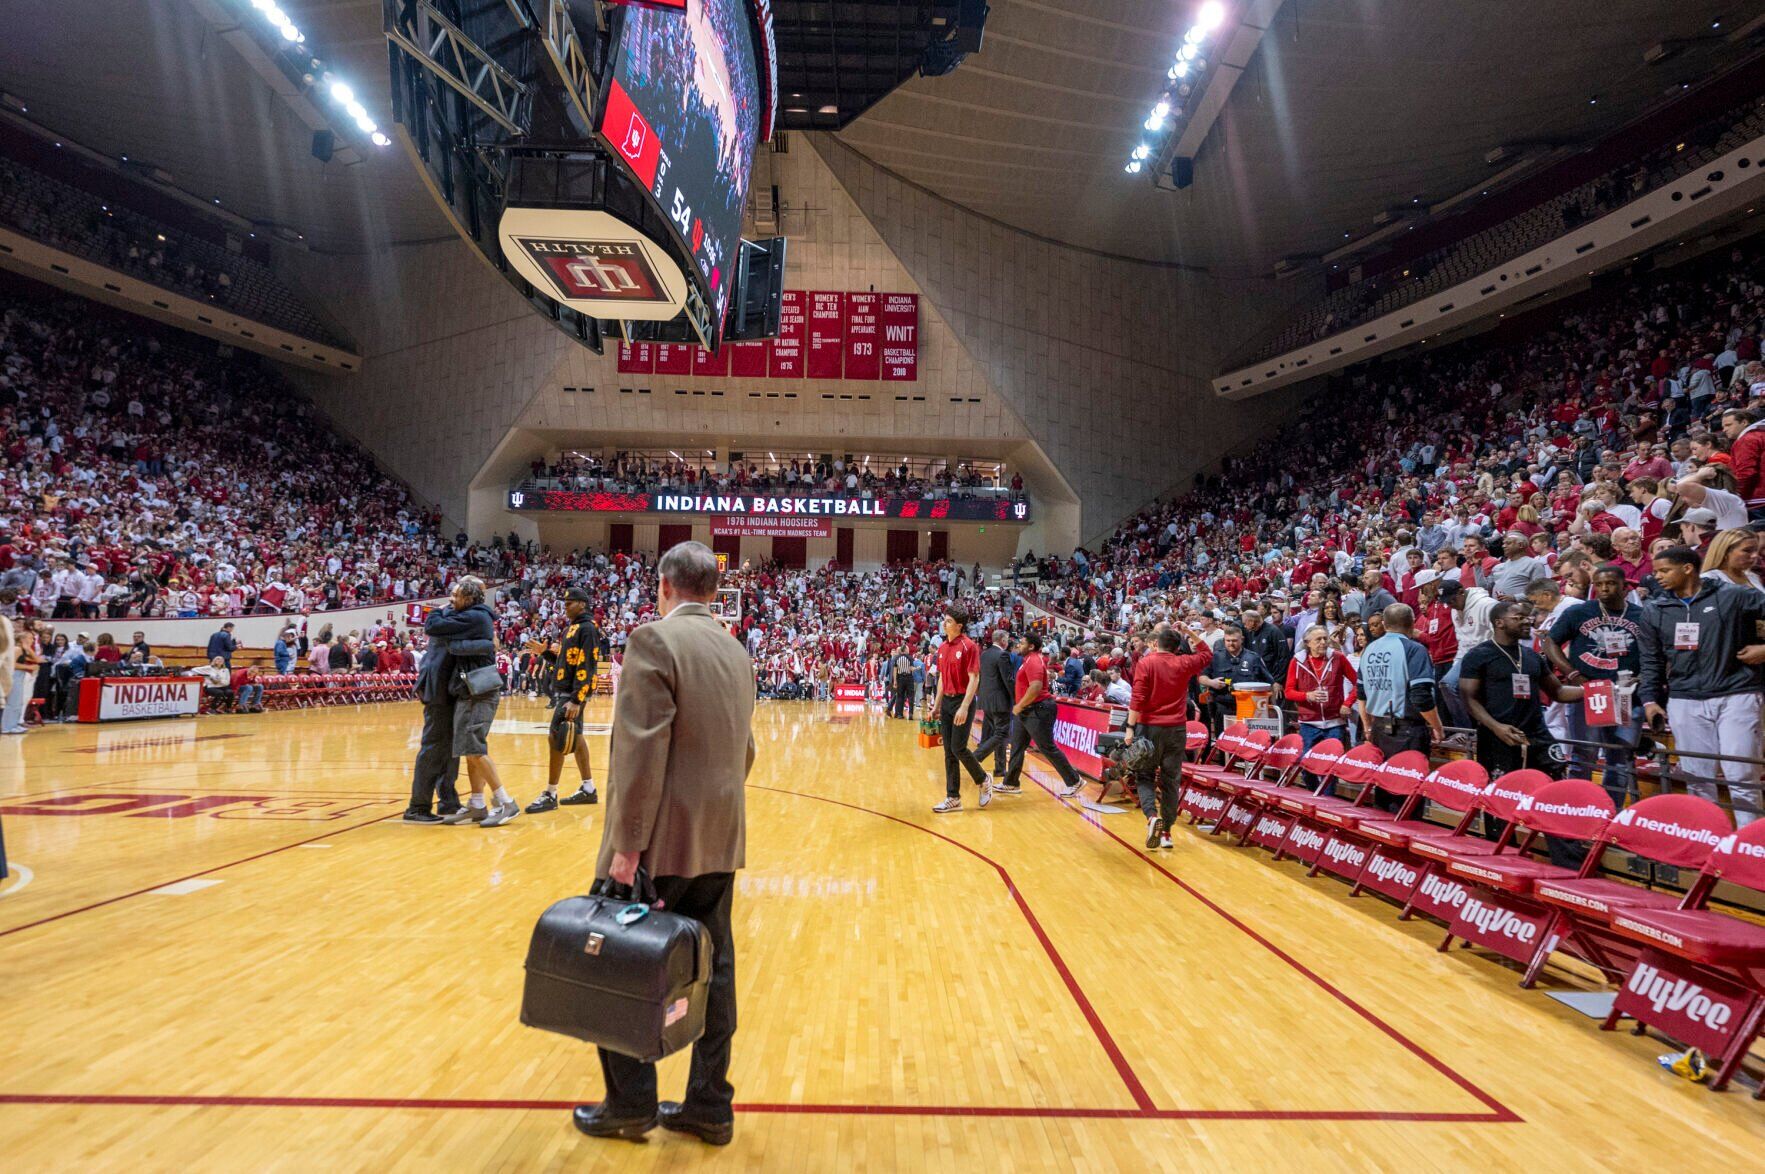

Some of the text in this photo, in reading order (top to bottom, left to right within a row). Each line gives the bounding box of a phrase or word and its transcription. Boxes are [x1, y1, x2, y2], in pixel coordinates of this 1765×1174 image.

[671, 186, 691, 236] 54
[529, 242, 635, 255] HEALTH
[815, 294, 839, 302] WOMEN'S
[852, 295, 876, 303] WOMEN'S
[889, 296, 912, 304] INDIANA
[828, 303, 838, 311] TEN
[884, 304, 915, 312] UNIVERSITY
[813, 311, 839, 319] CHAMPIONS
[851, 326, 876, 334] APPEARANCE
[886, 325, 914, 342] WNIT
[854, 342, 872, 356] 1973
[884, 348, 915, 356] BASKETBALL
[781, 362, 793, 370] 1975
[657, 495, 885, 515] INDIANA BASKETBALL
[726, 517, 818, 528] 1976 INDIANA HOOSIERS
[741, 528, 766, 536] ALL-TIME
[1367, 652, 1391, 664] CSC
[114, 683, 188, 705] INDIANA
[121, 702, 180, 716] BASKETBALL
[1534, 801, 1611, 819] nerdwallet
[1635, 816, 1720, 846] nerdwalle
